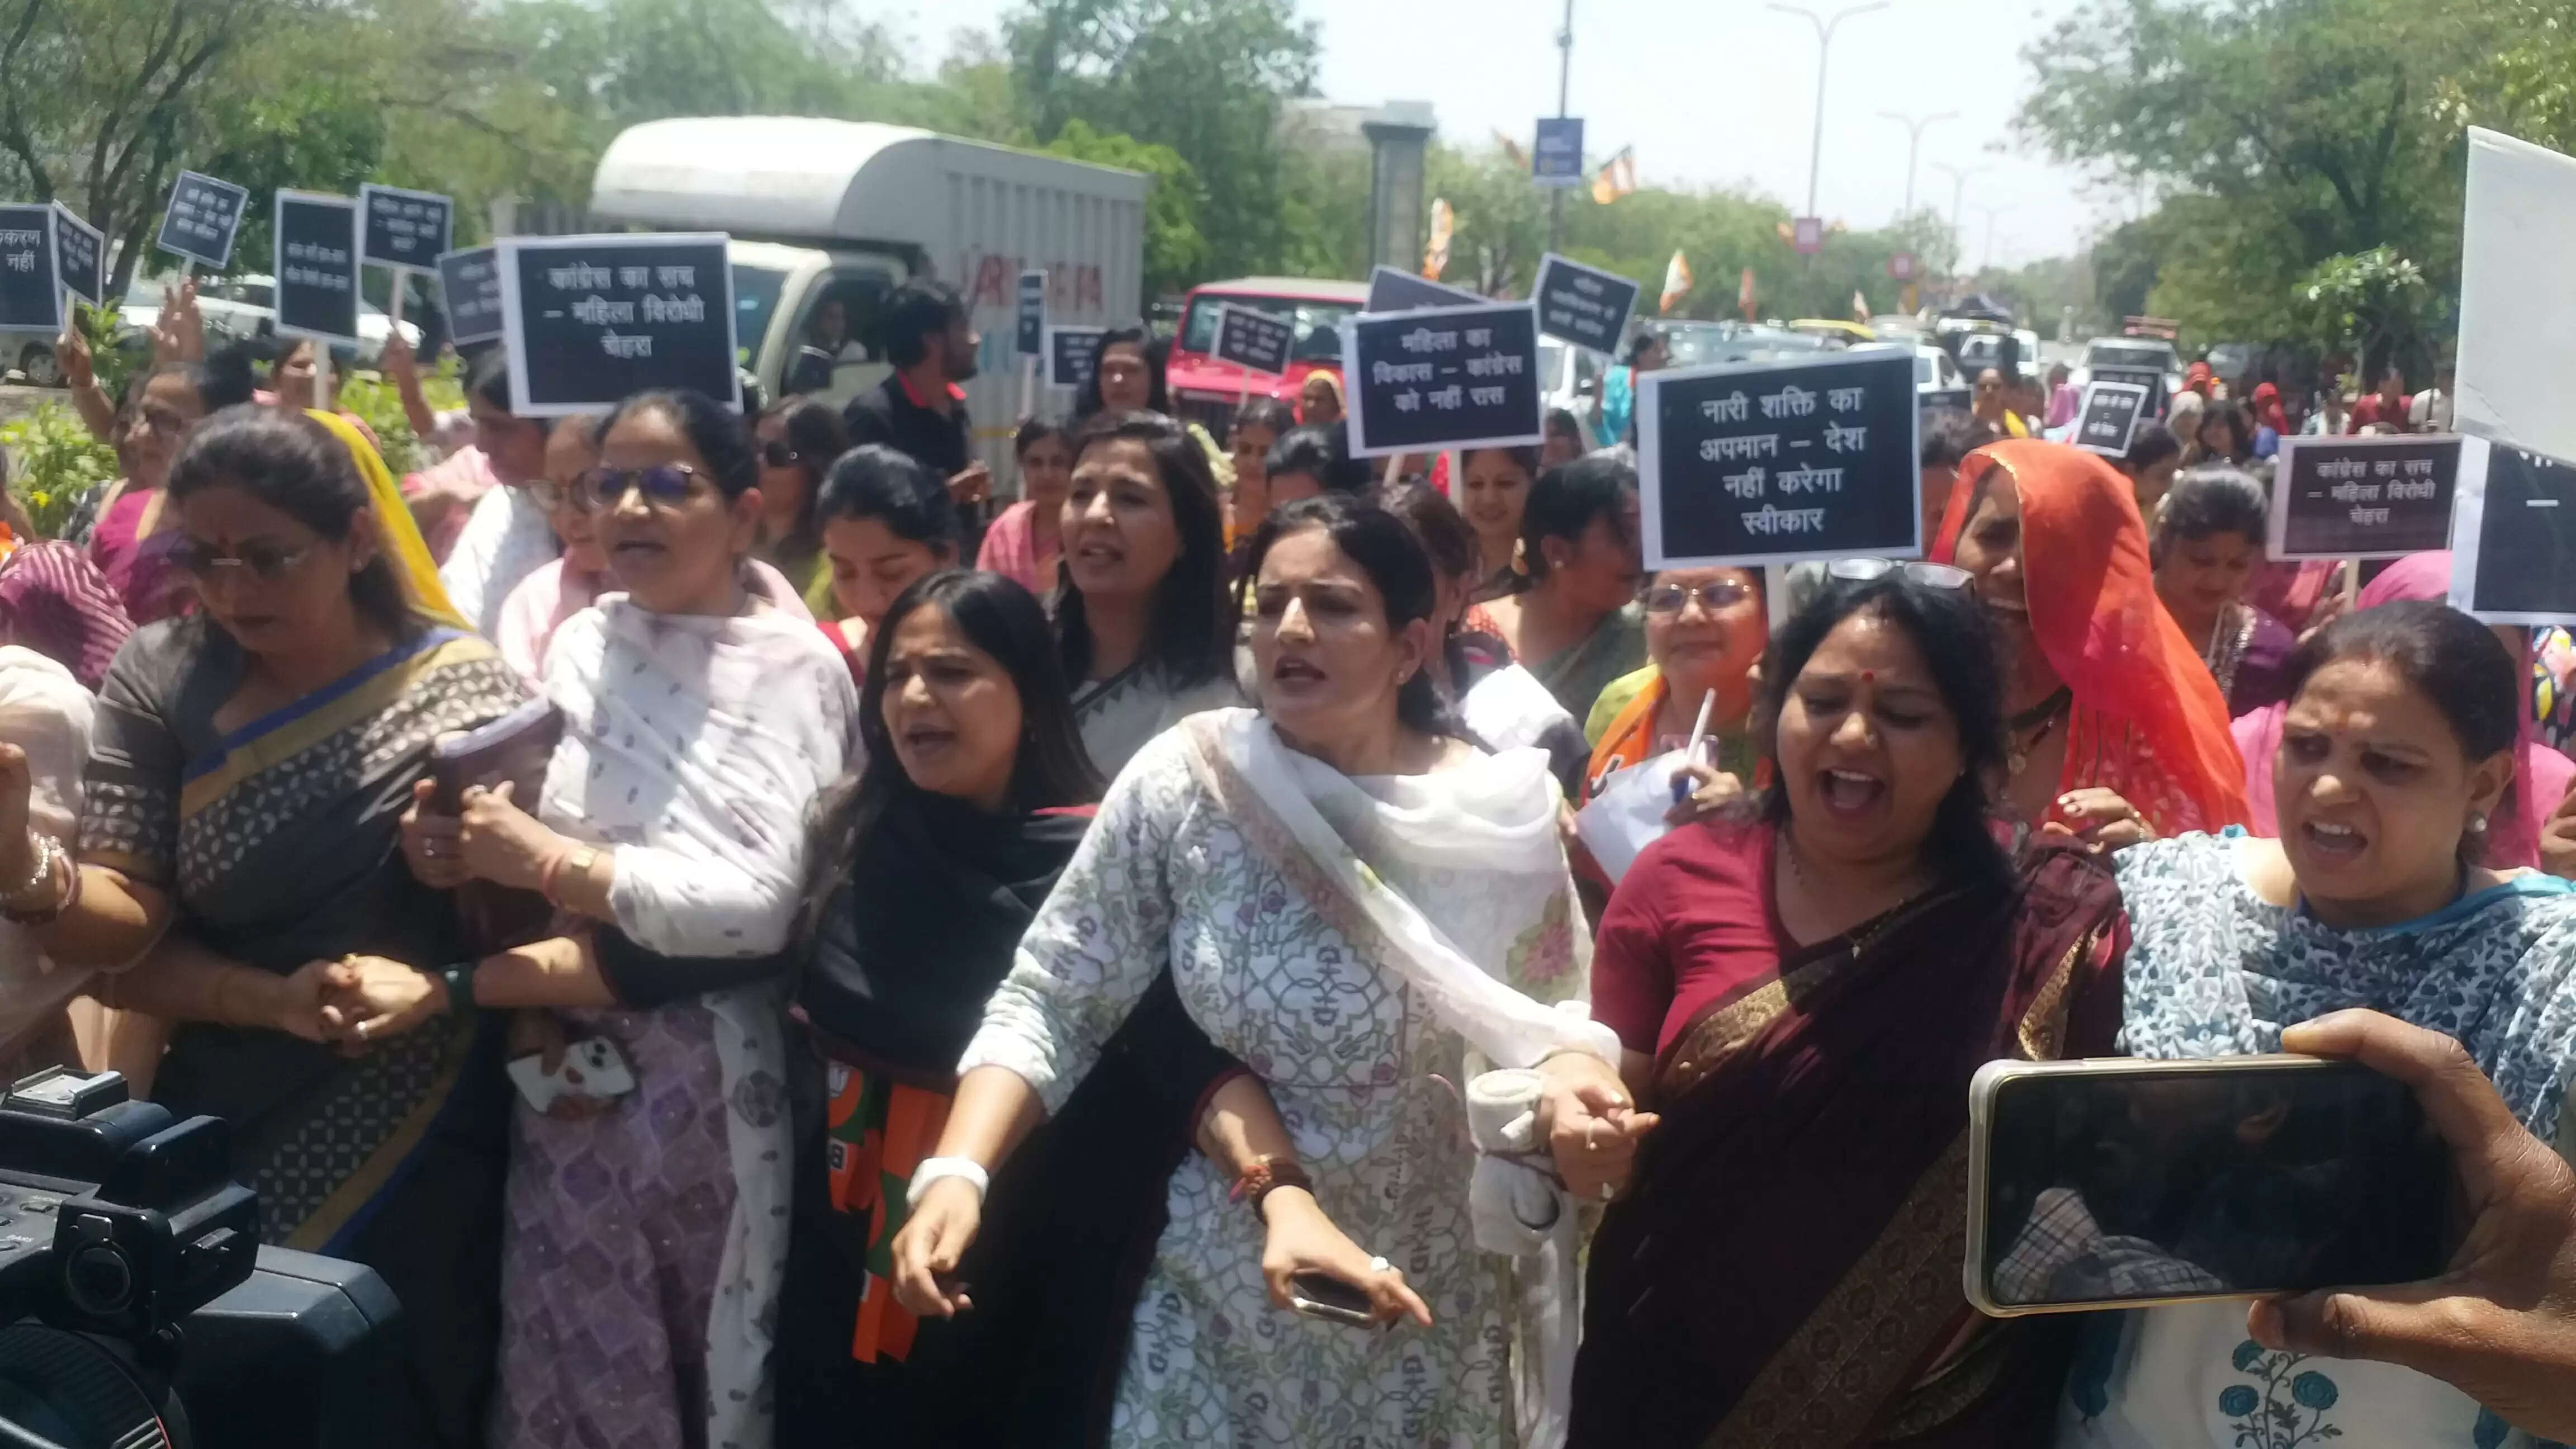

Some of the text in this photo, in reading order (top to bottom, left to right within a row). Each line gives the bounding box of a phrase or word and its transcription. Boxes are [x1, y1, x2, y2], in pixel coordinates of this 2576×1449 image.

[6, 249, 35, 272] नहीं
[550, 262, 694, 288] कांग्रेस का सच
[572, 295, 634, 325] महिला
[642, 294, 704, 321] विरोधी
[601, 329, 652, 358] चेहरा
[1401, 328, 1491, 352] महिला का
[1372, 361, 1433, 384] विकास
[1466, 351, 1522, 376] कांग्रेस
[1394, 385, 1505, 411] को नहीं रास
[1702, 385, 1864, 423] नारी शक्ति का
[1700, 434, 1779, 461] अपमान
[1824, 420, 1866, 453] देश
[1722, 462, 1843, 498] नहीं करेगा
[1741, 504, 1824, 534] स्वीकार
